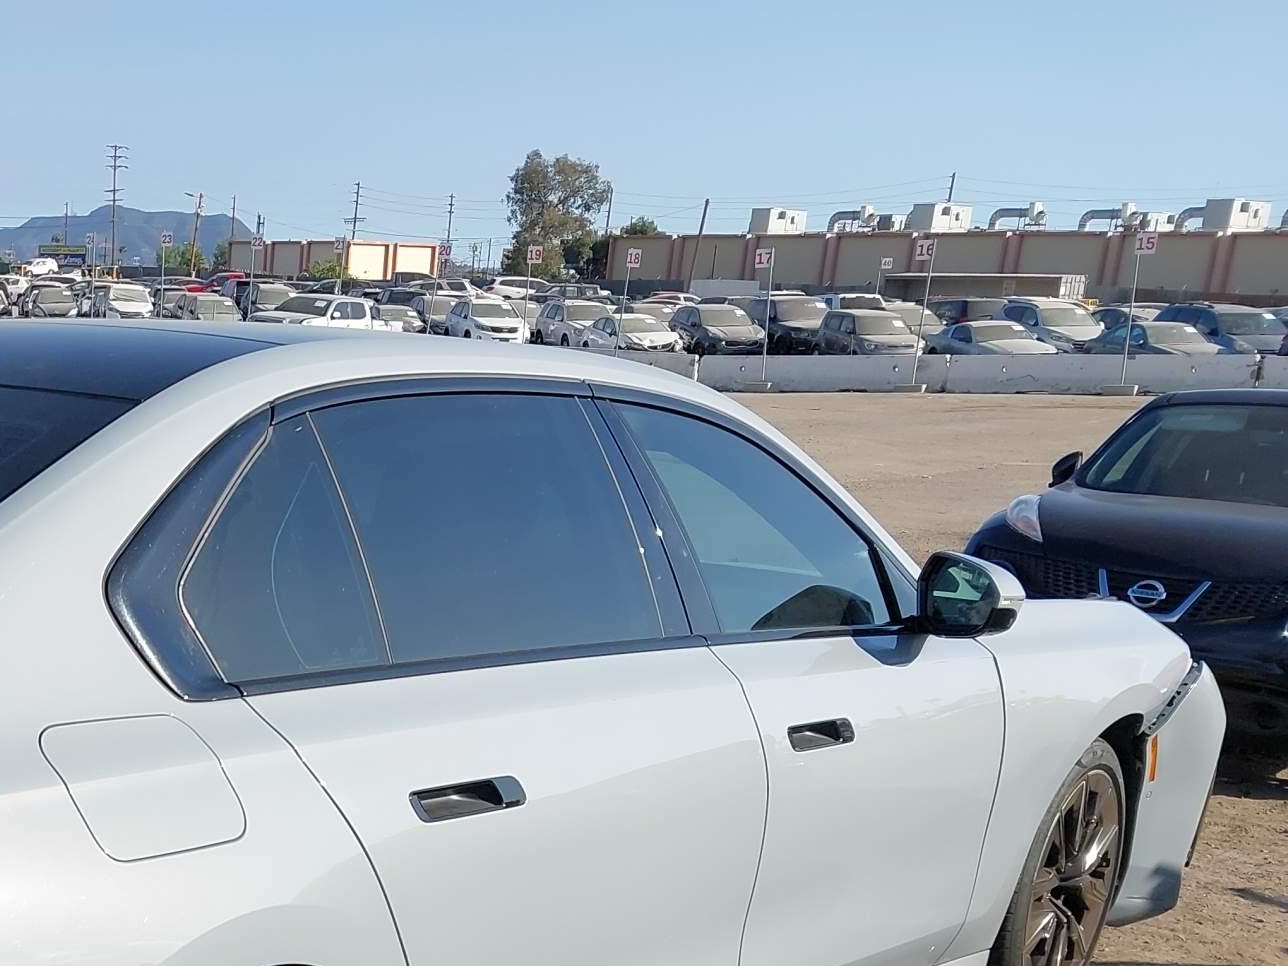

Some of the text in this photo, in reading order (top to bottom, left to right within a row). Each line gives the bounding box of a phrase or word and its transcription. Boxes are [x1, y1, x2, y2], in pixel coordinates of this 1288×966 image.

[162, 234, 172, 244] 23
[252, 237, 263, 247] 22
[1136, 236, 1156, 250] 15
[440, 245, 452, 256] 20
[528, 249, 542, 261] 19
[917, 243, 934, 257] 16
[627, 252, 640, 264] 18
[756, 252, 772, 265] 17
